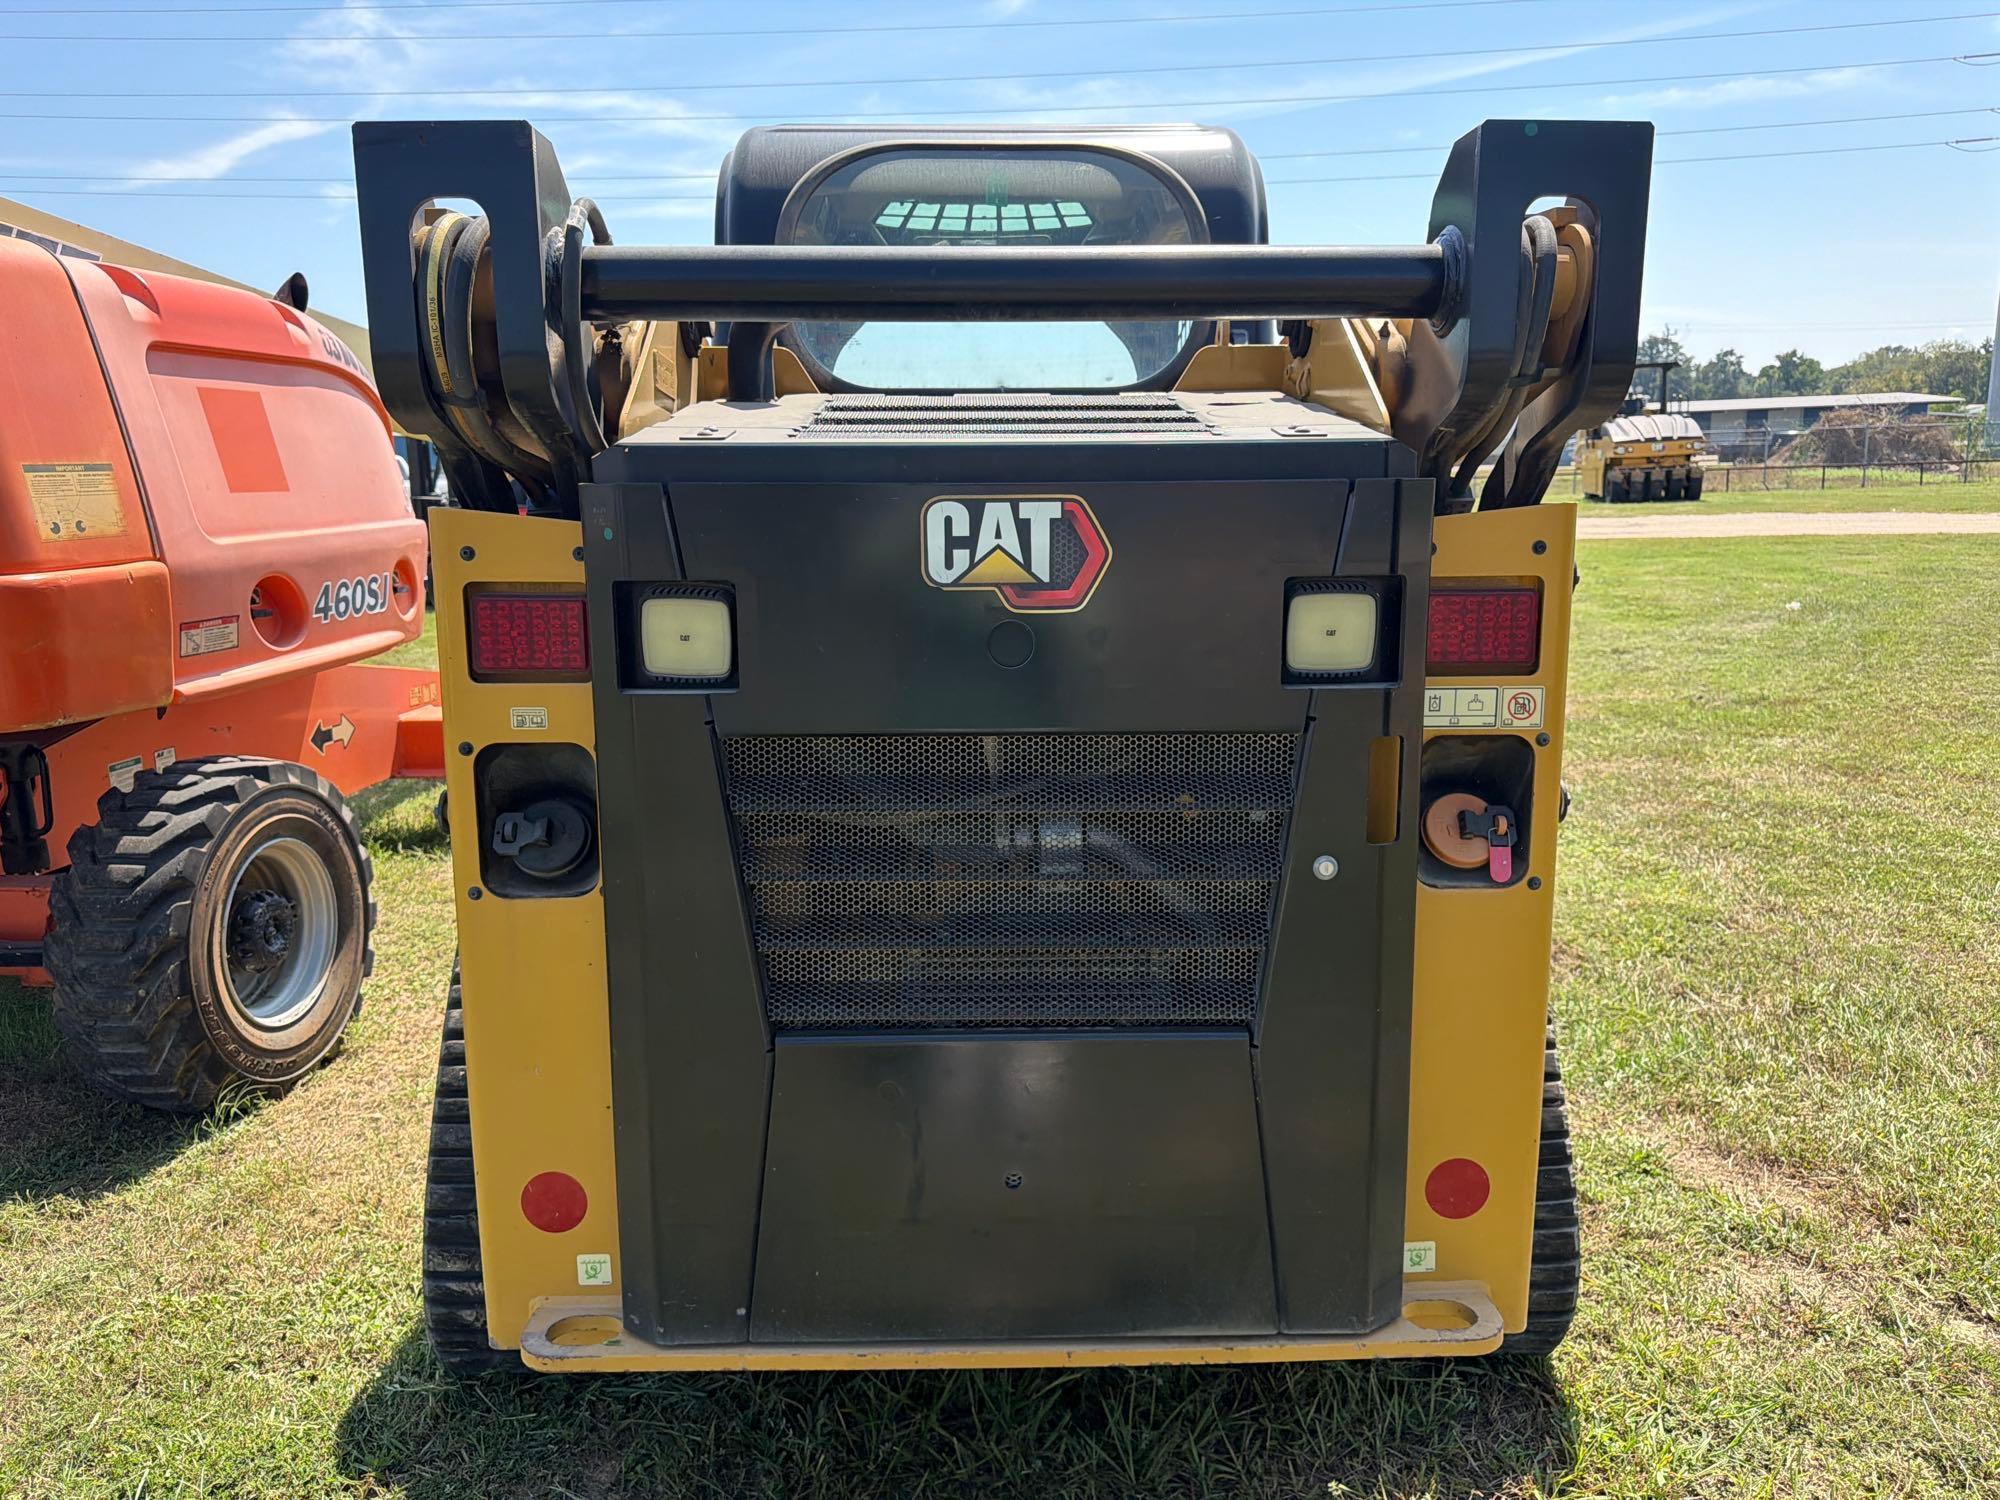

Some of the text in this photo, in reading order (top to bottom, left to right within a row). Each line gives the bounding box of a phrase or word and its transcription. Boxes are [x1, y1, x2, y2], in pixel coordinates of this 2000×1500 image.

[432, 336, 443, 358] MSHA
[926, 501, 1062, 584] CAT
[313, 572, 389, 622] 460SJ
[679, 634, 691, 642] CAT
[1325, 629, 1337, 637] CAT
